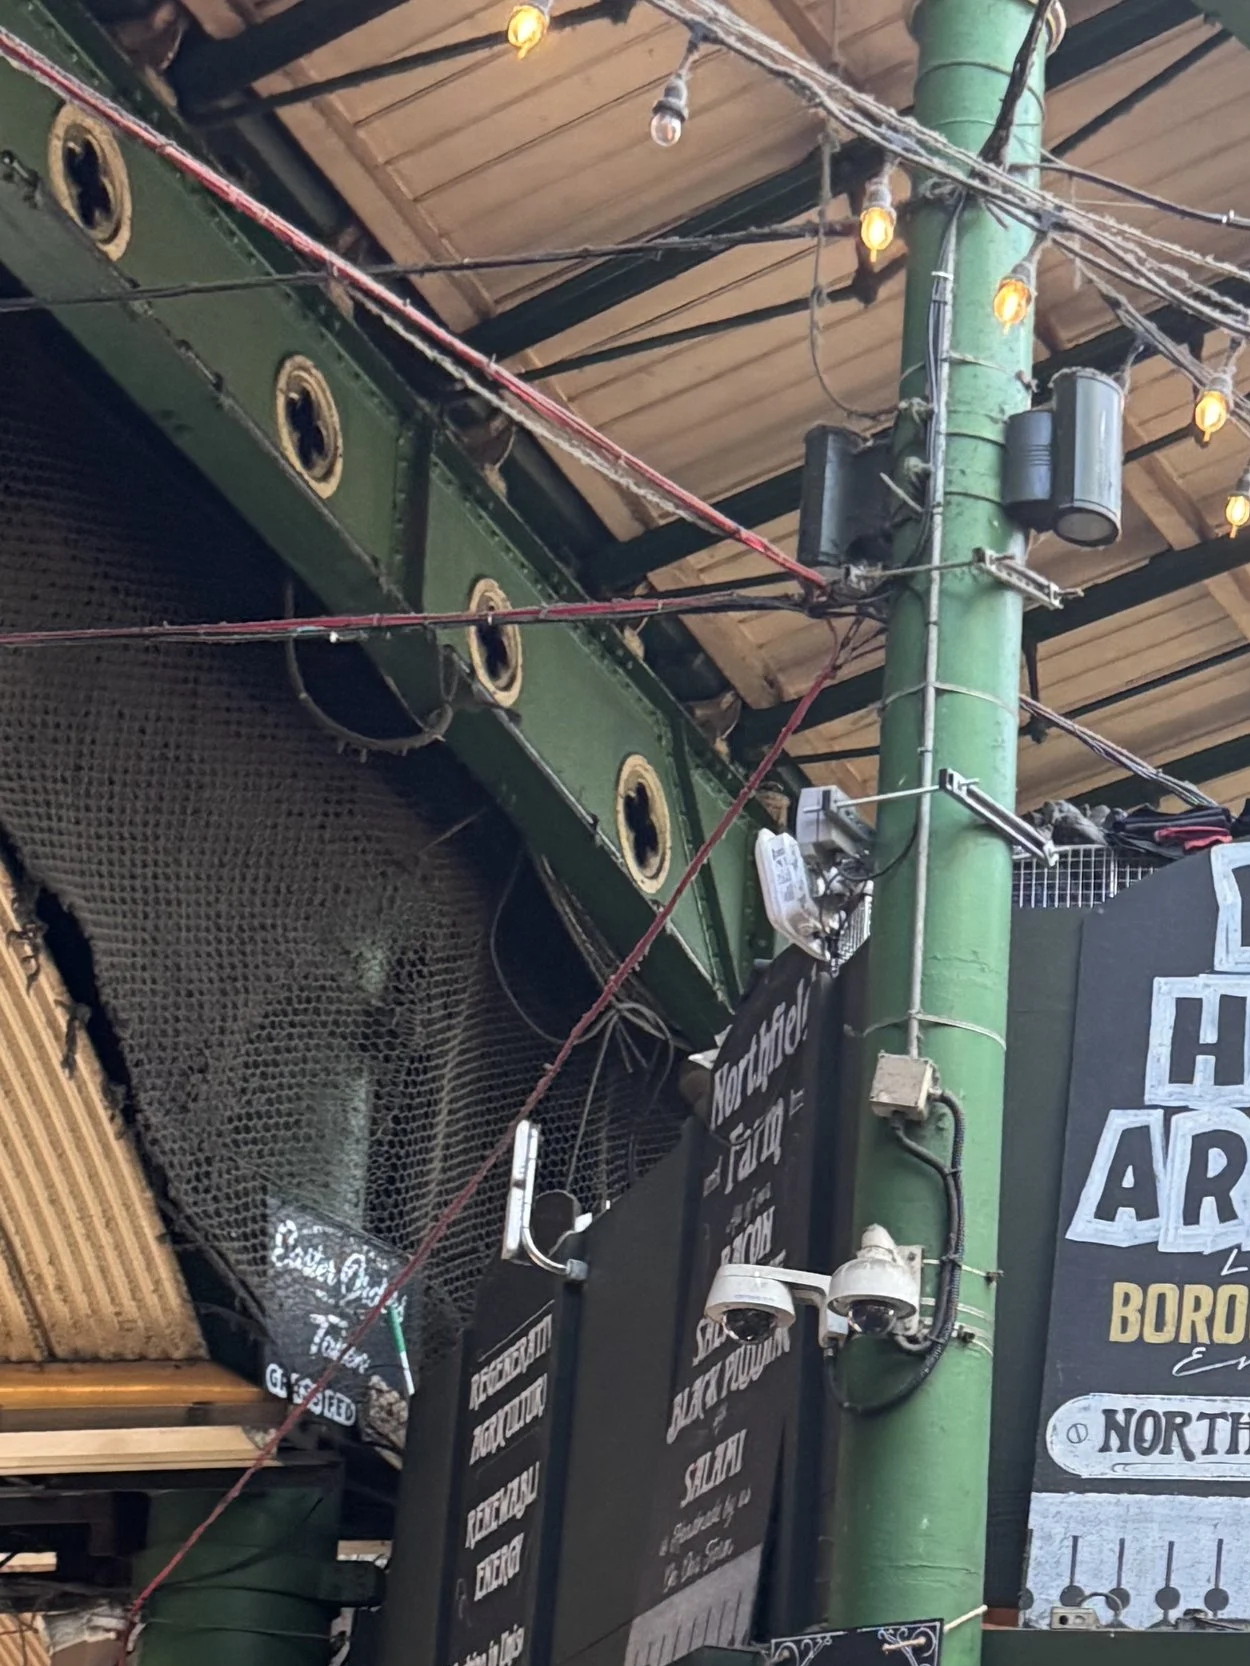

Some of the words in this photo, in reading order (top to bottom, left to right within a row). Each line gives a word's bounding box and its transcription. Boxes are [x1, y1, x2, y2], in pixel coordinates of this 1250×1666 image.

[724, 1097, 784, 1195] Farm
[680, 1428, 748, 1509] SALAMI
[474, 1532, 524, 1601] ENERGY
